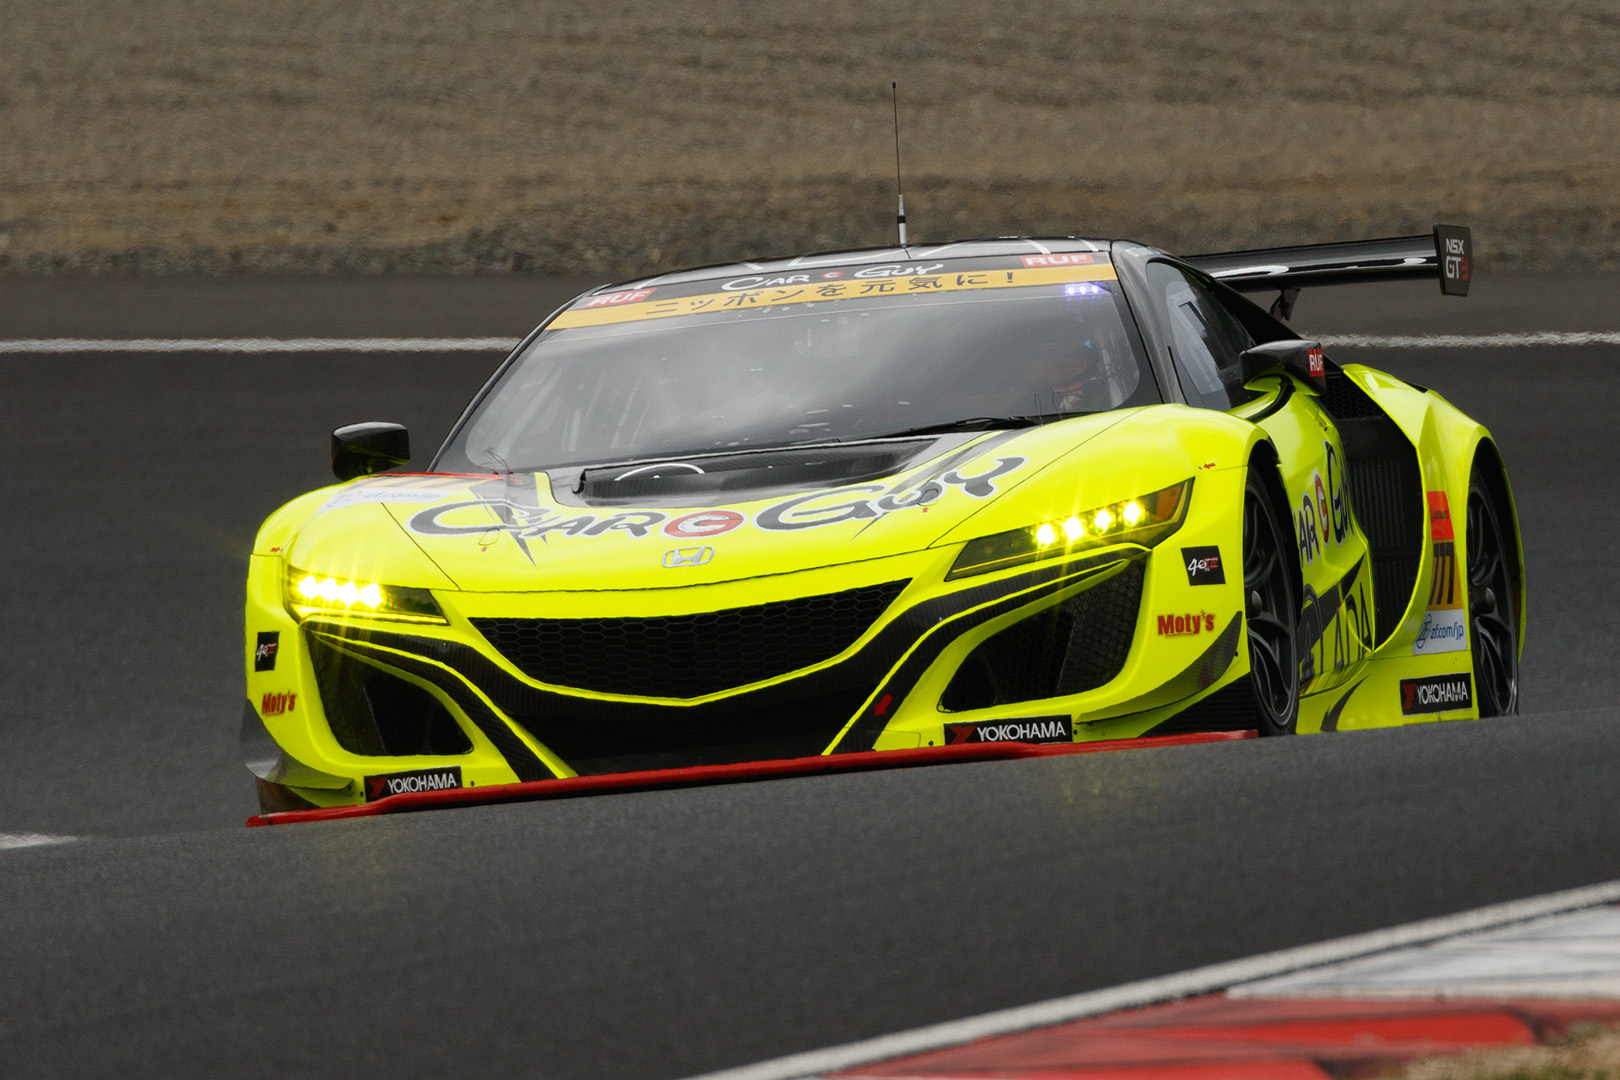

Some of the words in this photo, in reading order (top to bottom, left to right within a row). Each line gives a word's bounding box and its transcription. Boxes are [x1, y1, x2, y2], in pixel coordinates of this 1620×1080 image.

[1445, 238, 1465, 255] NSX
[1025, 254, 1090, 266] RUF
[1445, 256, 1469, 280] GT3
[589, 289, 651, 307] RUF
[1309, 354, 1323, 372] RUF
[1293, 490, 1321, 572] AR
[1157, 610, 1215, 636] Moty's
[1430, 621, 1464, 640] zf.com/jp
[261, 690, 296, 716] Moty's
[1416, 681, 1469, 705] YOKOHAMA
[977, 721, 1066, 742] YOKOHAMA
[387, 772, 457, 794] YOKOHAMA
